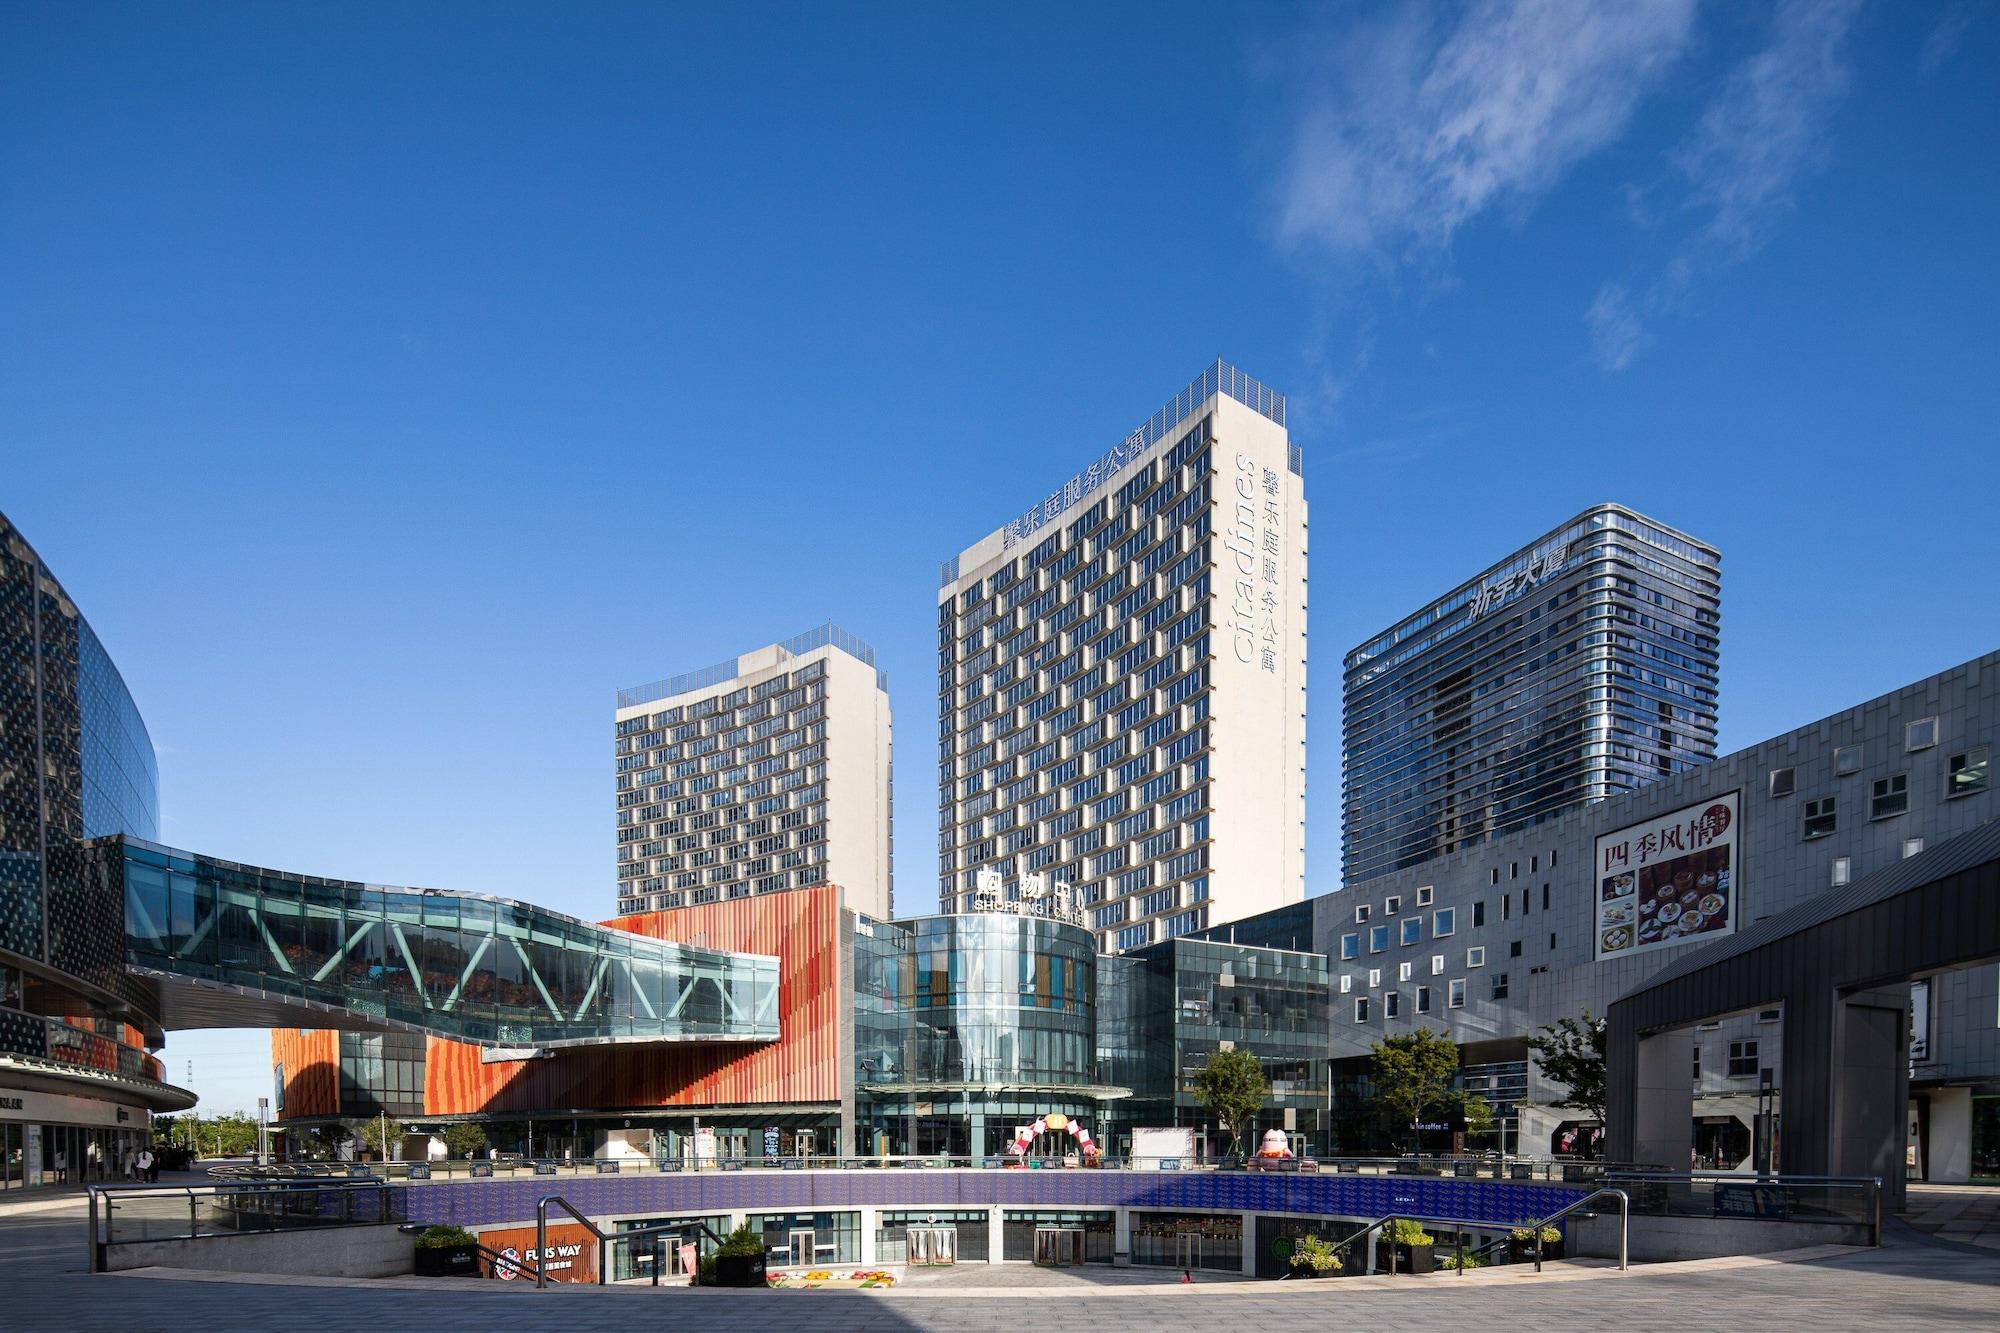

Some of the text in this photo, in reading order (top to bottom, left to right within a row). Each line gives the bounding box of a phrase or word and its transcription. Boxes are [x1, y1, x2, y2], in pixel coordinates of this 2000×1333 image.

[1605, 815, 1716, 872] 四季风情
[974, 899, 1086, 928] SHOPPING CENTE
[1409, 1122, 1425, 1130] lukin
[1425, 1122, 1442, 1130] coffee
[557, 1244, 581, 1257] WAY
